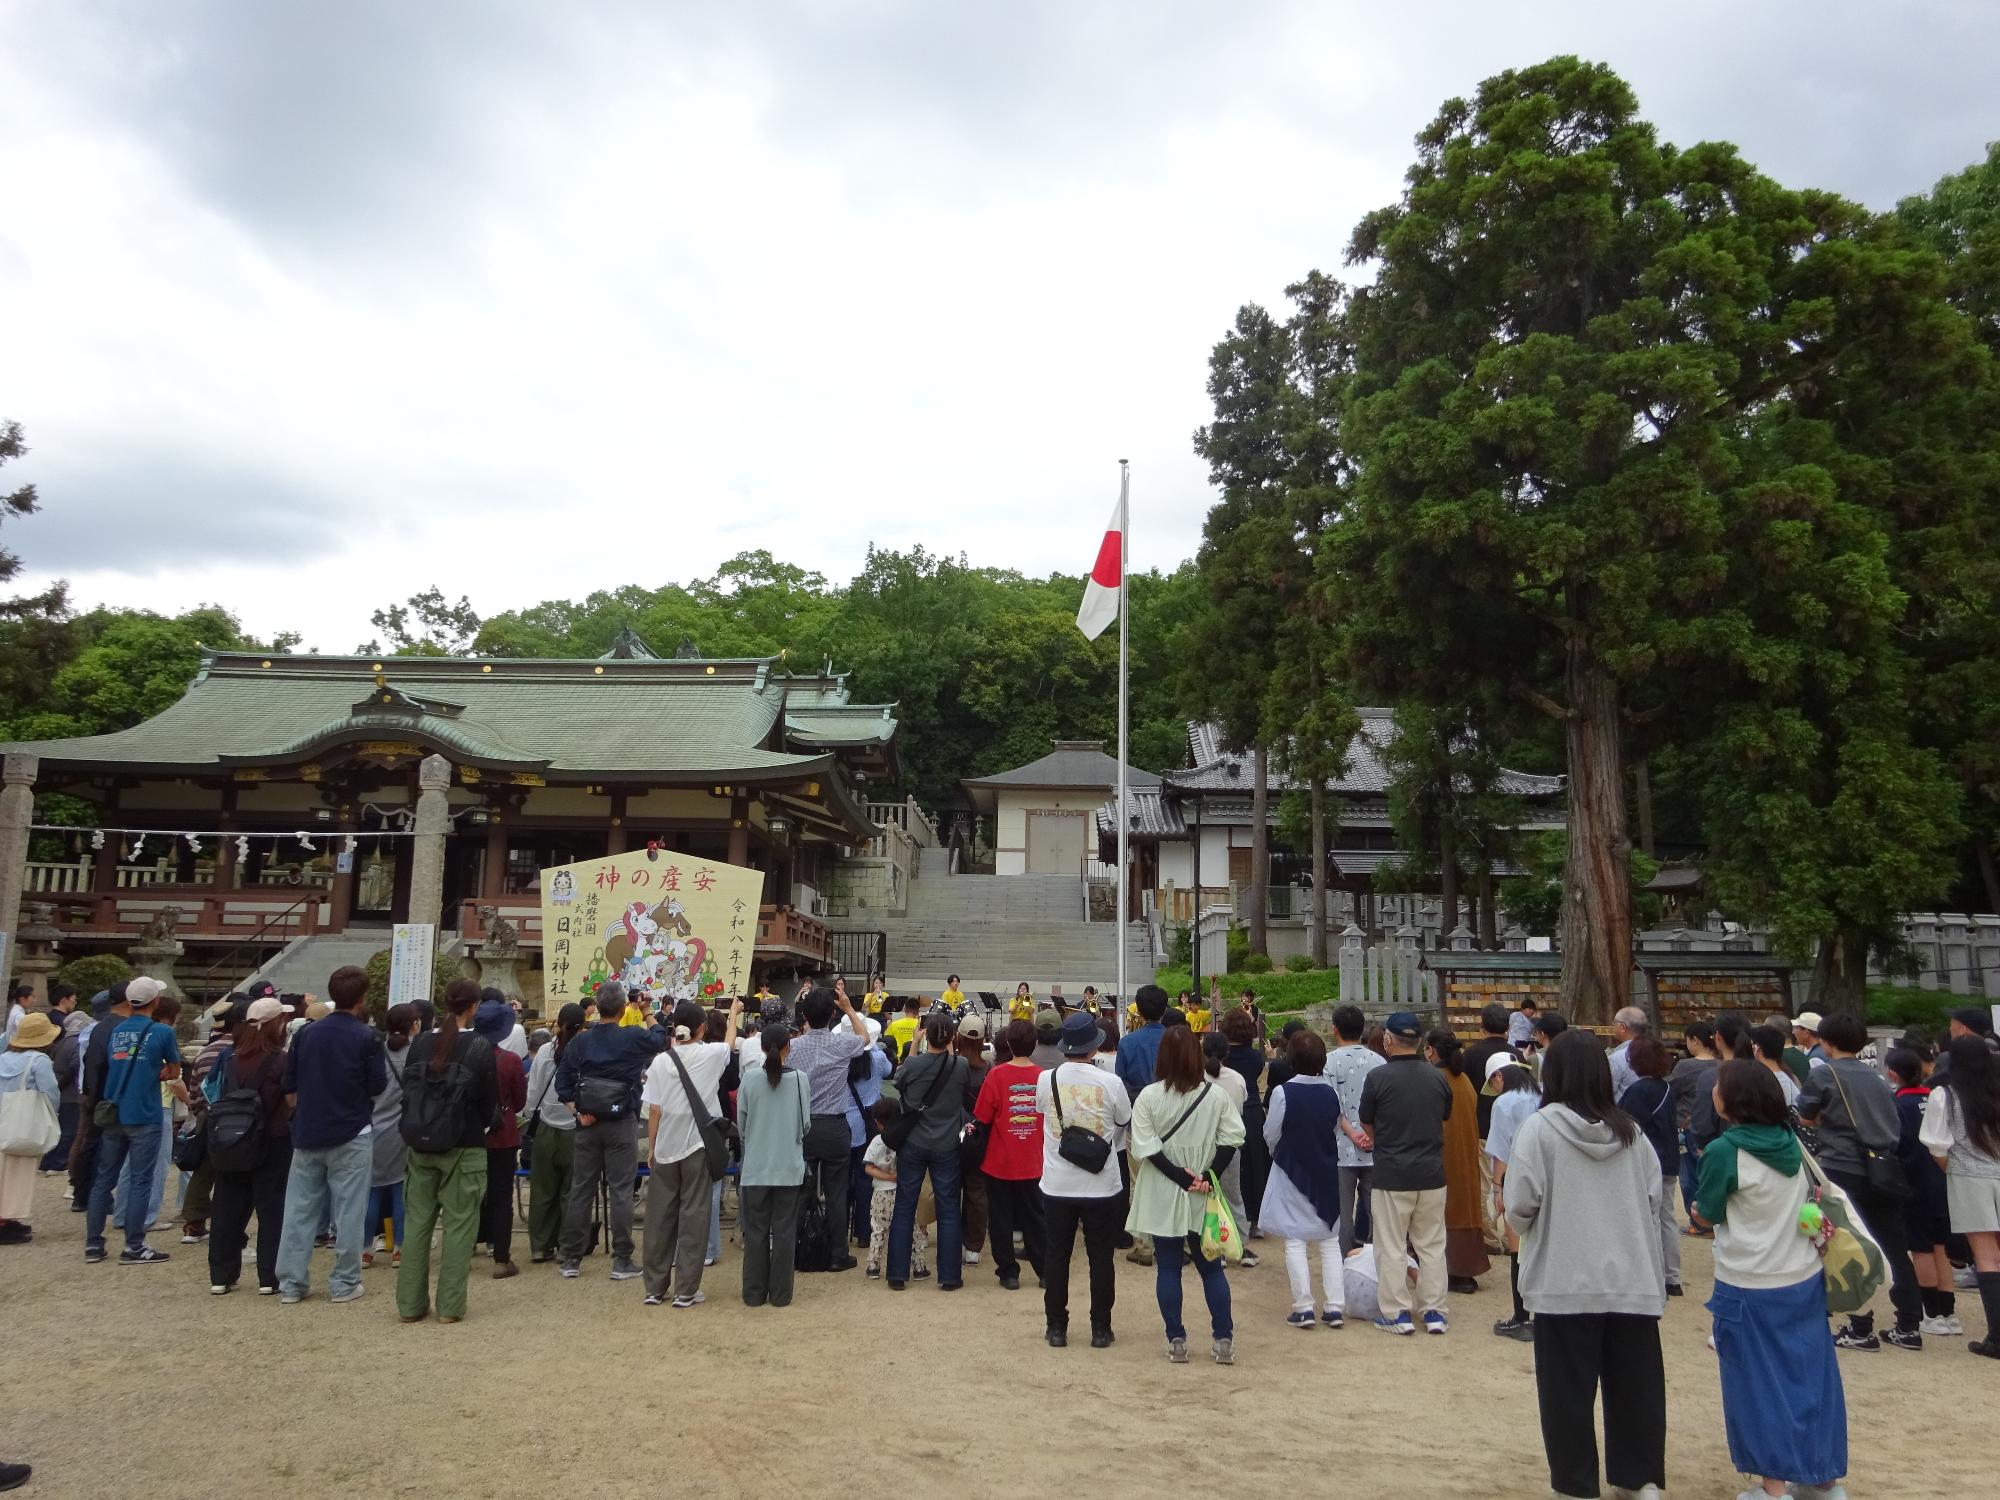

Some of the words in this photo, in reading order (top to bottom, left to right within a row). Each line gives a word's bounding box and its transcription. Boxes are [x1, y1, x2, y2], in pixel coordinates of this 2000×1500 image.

[571, 903, 583, 938] 式内社
[585, 892, 600, 935] 播磨国
[550, 916, 570, 996] 日岡神社
[728, 898, 746, 997] 令和八年午年
